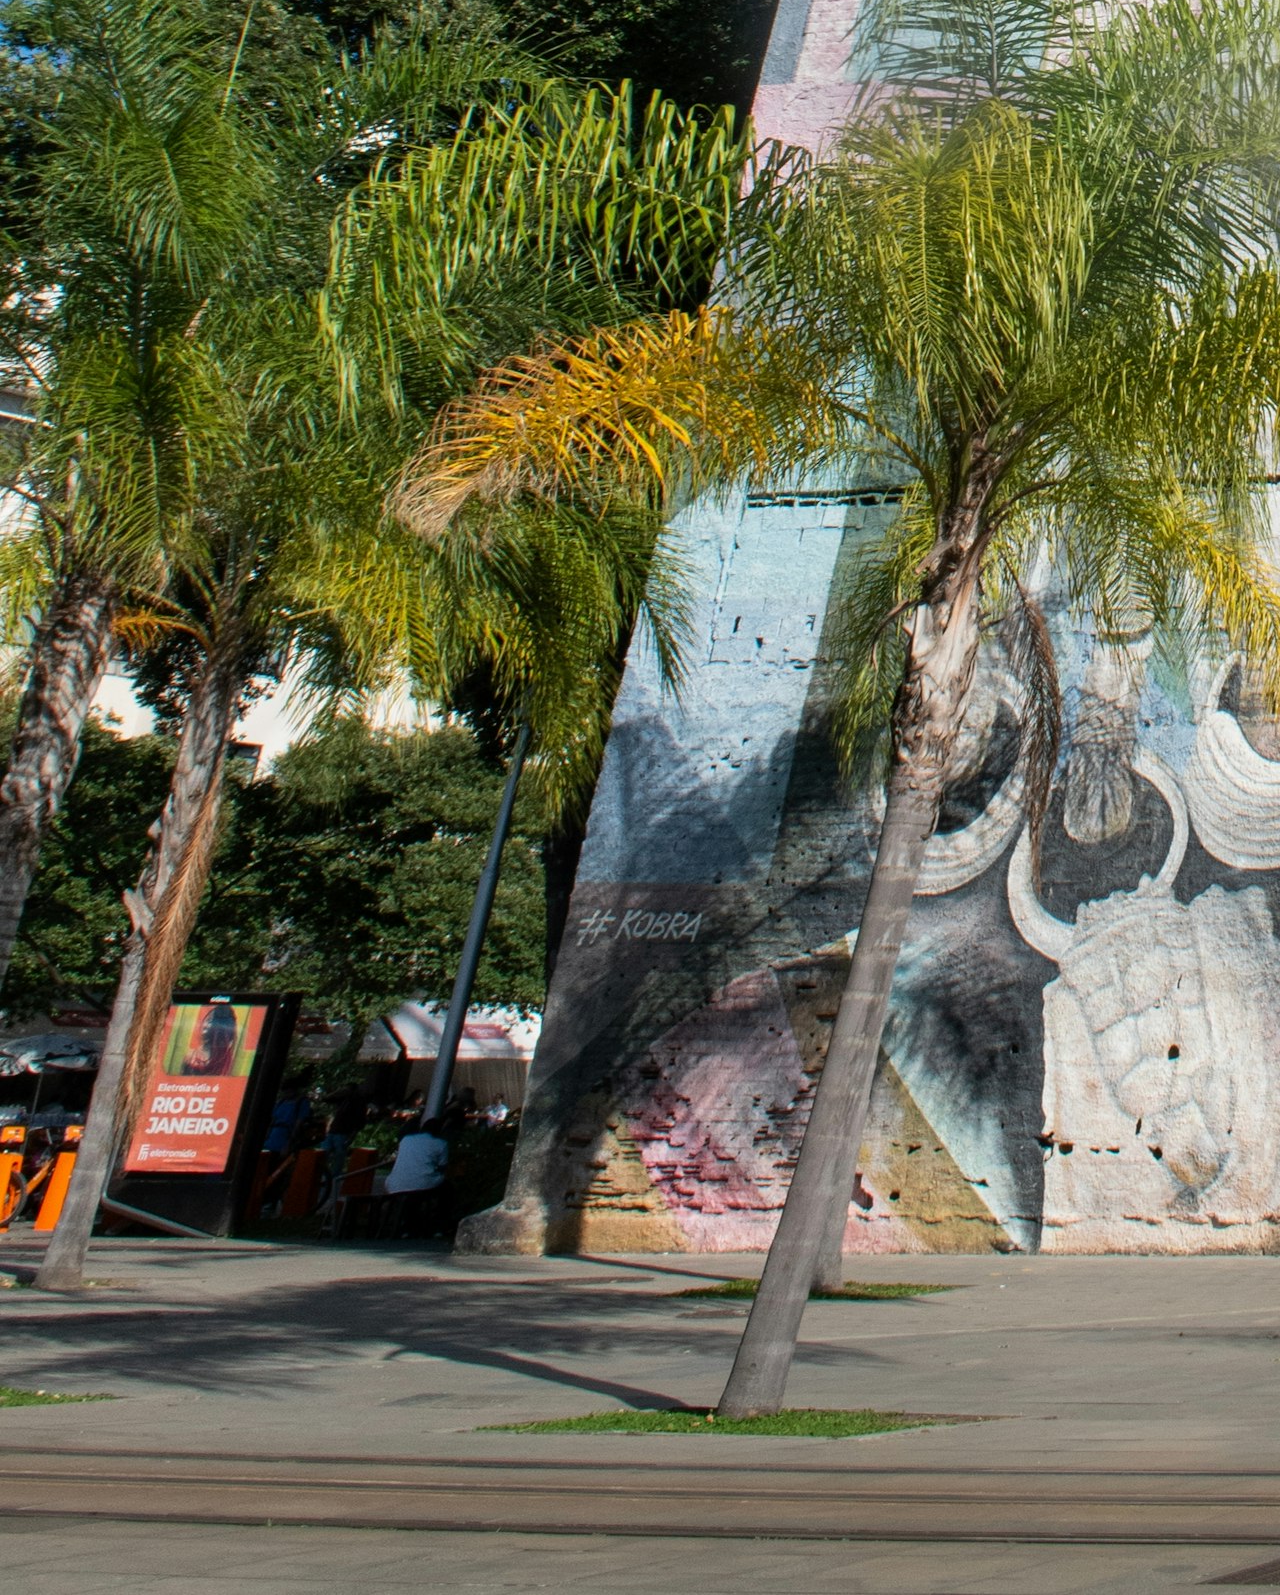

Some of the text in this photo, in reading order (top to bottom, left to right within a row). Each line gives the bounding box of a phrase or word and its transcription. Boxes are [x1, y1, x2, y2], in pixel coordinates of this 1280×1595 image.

[151, 1096, 216, 1114] RIO DE
[145, 1117, 229, 1135] JANEIRO
